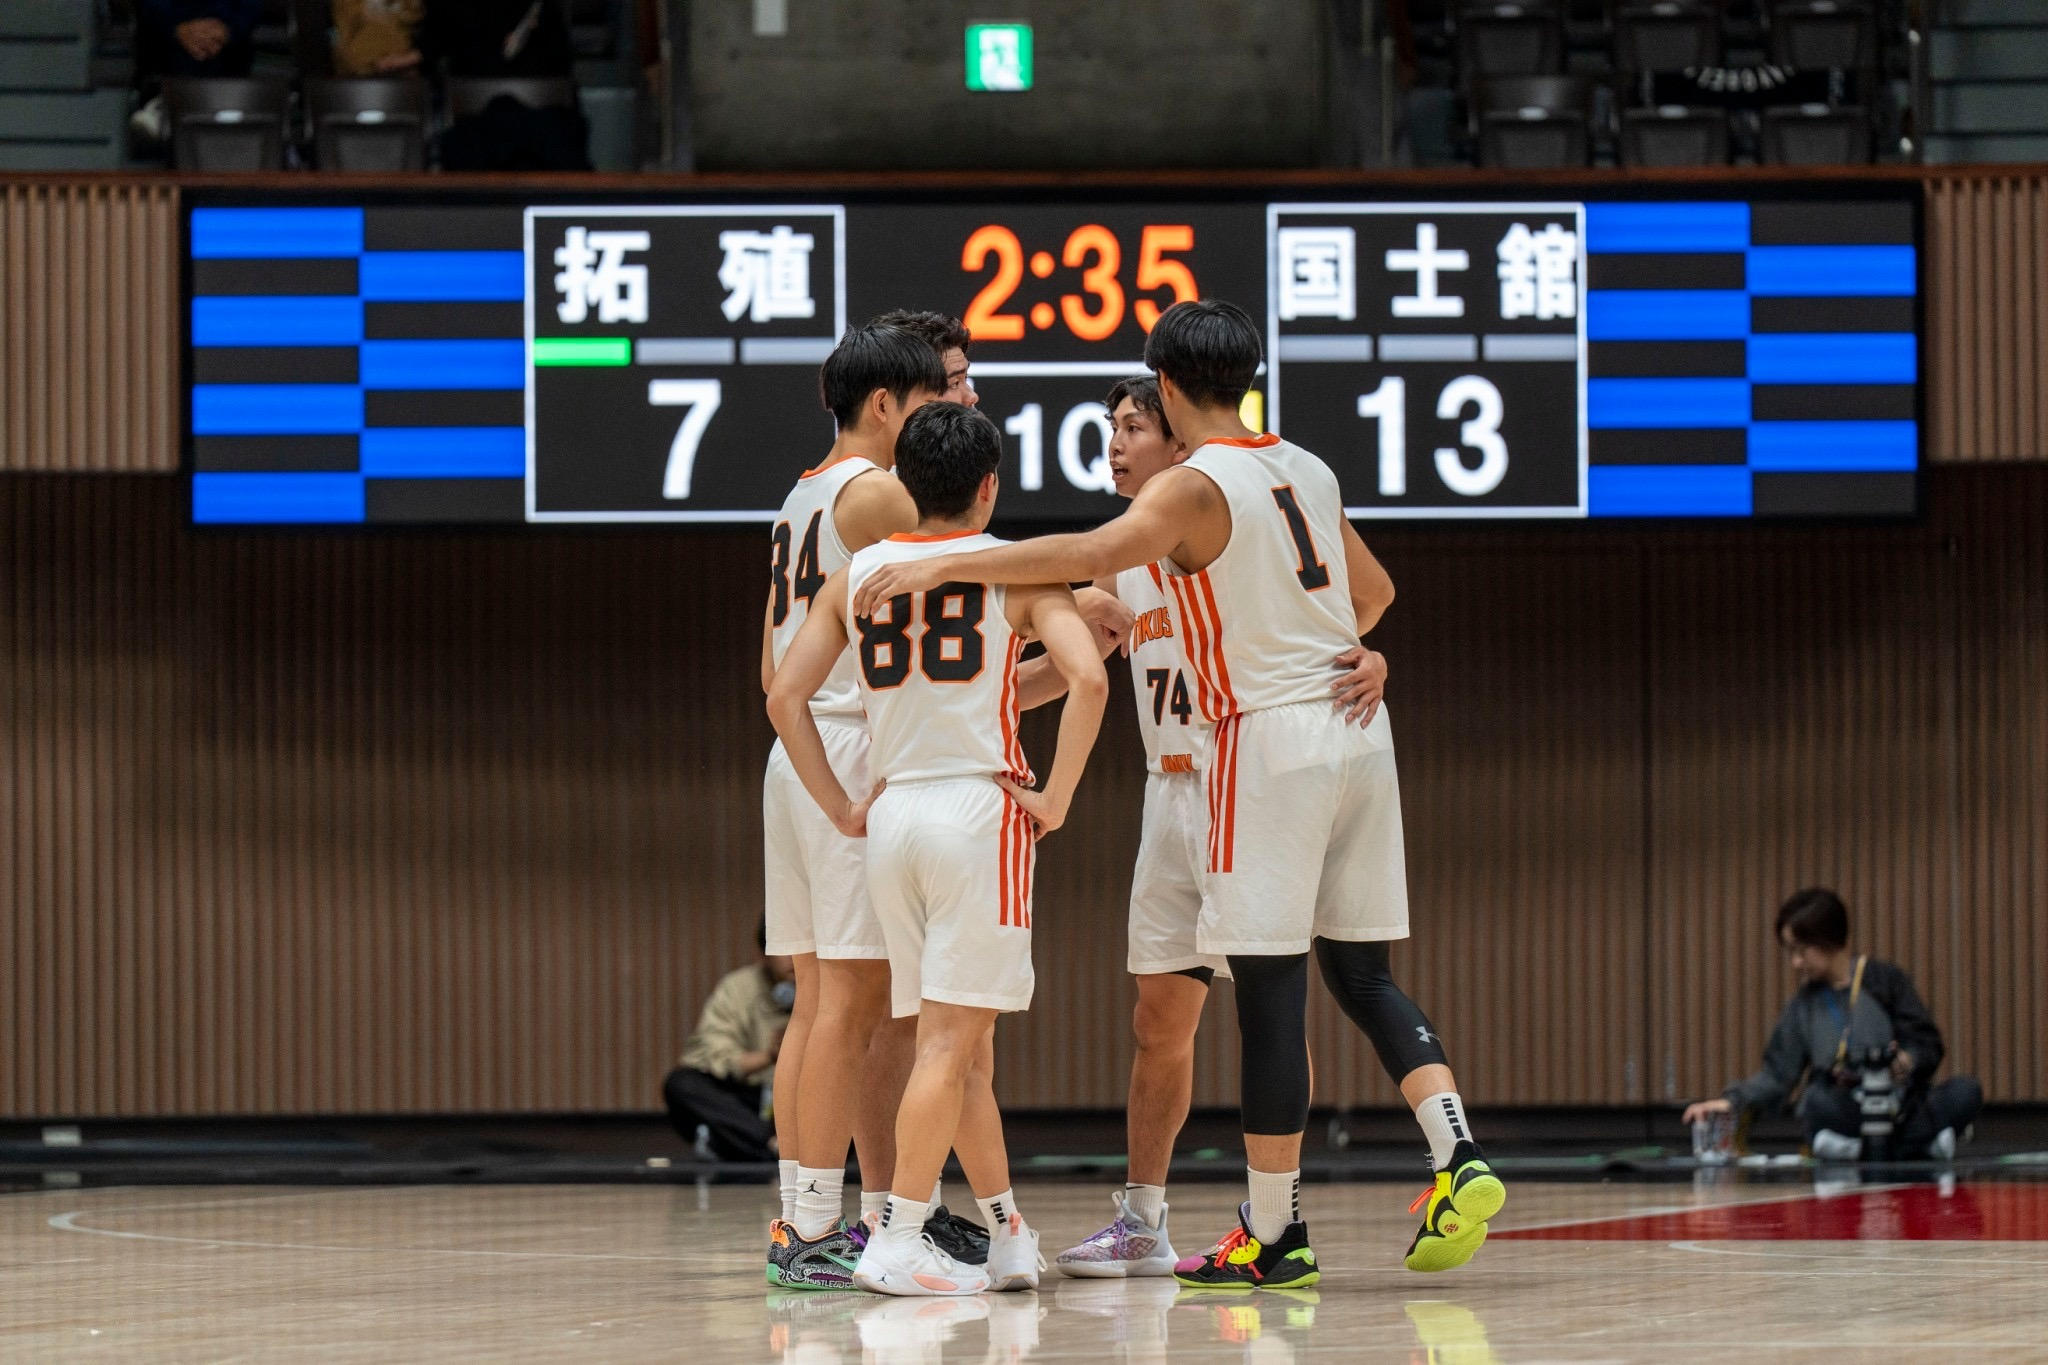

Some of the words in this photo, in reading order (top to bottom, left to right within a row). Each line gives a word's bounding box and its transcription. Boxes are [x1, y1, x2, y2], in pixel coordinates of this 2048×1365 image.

[961, 224, 1199, 341] 2:35
[648, 378, 722, 500] 7
[1005, 401, 1117, 495] 1Q
[1357, 374, 1509, 497] 13
[1270, 484, 1332, 593] 1
[853, 580, 988, 692] 88
[1145, 667, 1193, 726] 74
